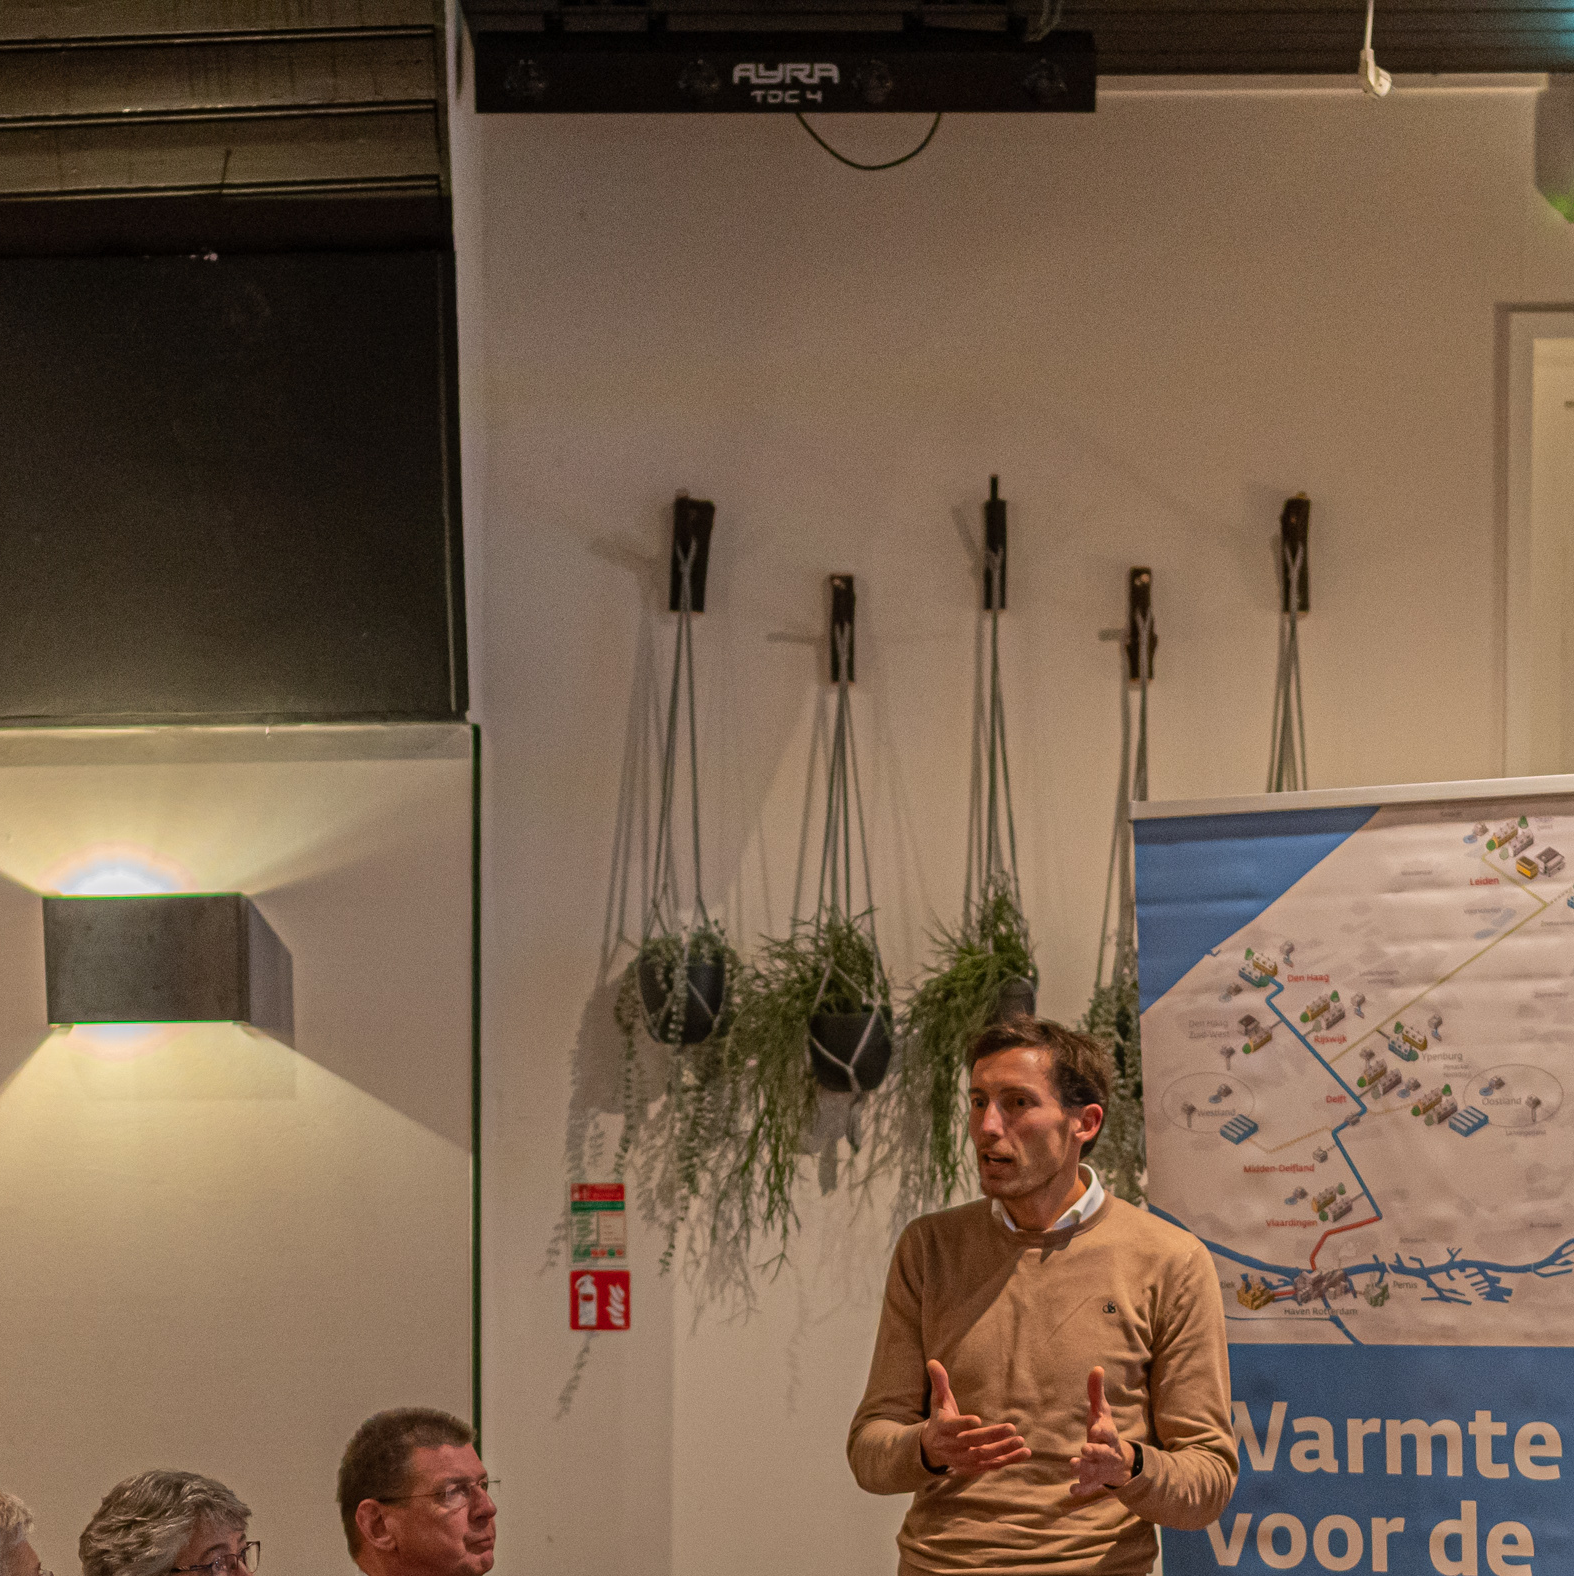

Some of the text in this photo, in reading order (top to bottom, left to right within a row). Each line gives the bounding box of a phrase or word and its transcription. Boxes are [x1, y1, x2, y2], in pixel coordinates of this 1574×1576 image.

[732, 63, 840, 84] AYRA
[806, 90, 823, 102] 4
[1469, 877, 1500, 886] Leiden
[1287, 974, 1330, 984] Den Haag
[1314, 1034, 1347, 1045] Rijswijk
[1421, 1051, 1463, 1063] Ypenburg
[1326, 1095, 1347, 1104] Delft
[1481, 1096, 1522, 1106] Oostland
[1196, 1108, 1236, 1117] Westland
[1243, 1163, 1315, 1174] Midden-Delfland
[1266, 1219, 1317, 1229] Vlaardingen
[1392, 1281, 1417, 1289] Pernis
[1284, 1307, 1358, 1316] Haven Rotterdam
[1206, 1512, 1405, 1572] voor
